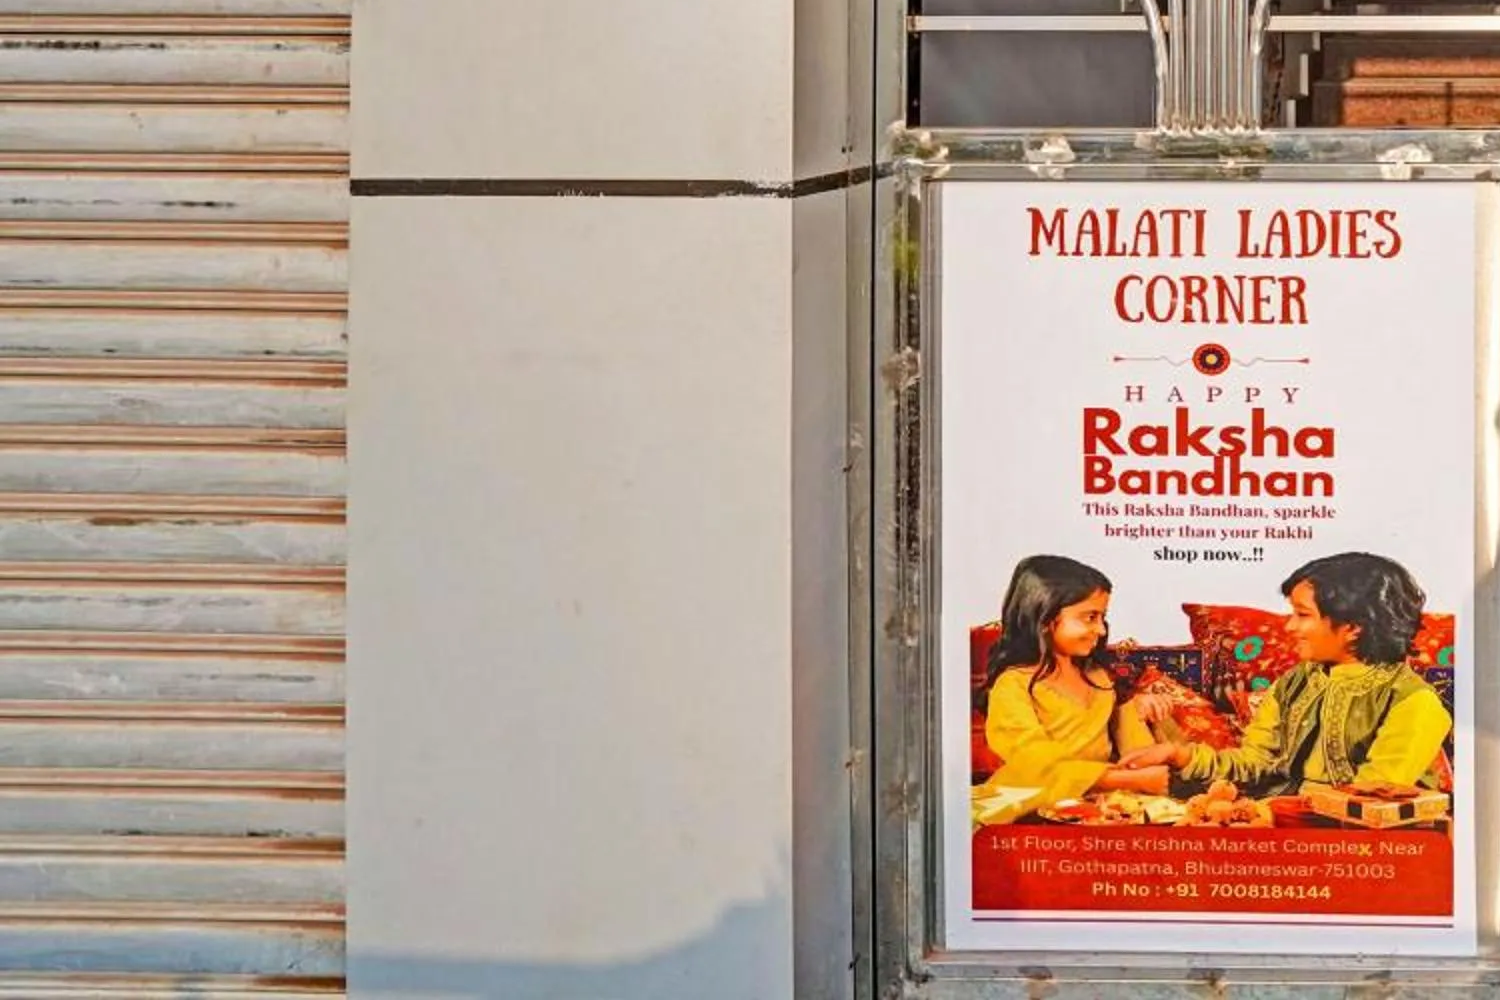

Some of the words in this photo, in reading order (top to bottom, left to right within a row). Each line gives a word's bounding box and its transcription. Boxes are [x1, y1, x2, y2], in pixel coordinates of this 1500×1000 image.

[1026, 207, 1208, 259] MALATI
[1237, 208, 1403, 260] LADIES
[1114, 274, 1309, 325] CORNER
[1124, 385, 1300, 403] HAPPY
[1083, 406, 1335, 458] Raksha
[1083, 455, 1335, 497] Bandhan
[1082, 502, 1119, 517] This
[1124, 503, 1185, 517] Raksha
[1273, 505, 1337, 520] sparkle
[1104, 524, 1175, 540] brighter
[1178, 524, 1217, 538] than
[1220, 529, 1260, 541] your
[1264, 526, 1313, 540] Rakhi
[1153, 546, 1198, 562] shop
[991, 836, 1018, 850] 1st
[1024, 836, 1077, 853] Floor,
[1083, 836, 1127, 851] Shre
[1132, 837, 1204, 851] Krishna
[1210, 838, 1277, 853] Market
[1379, 841, 1426, 855] Near
[1058, 859, 1180, 877] Gothapatna,
[1185, 860, 1396, 879] Bhubaneswar-751003
[1092, 882, 1118, 897] Ph
[1123, 882, 1150, 897] No
[1165, 882, 1200, 898] +91
[1209, 882, 1333, 900] 7008184144
